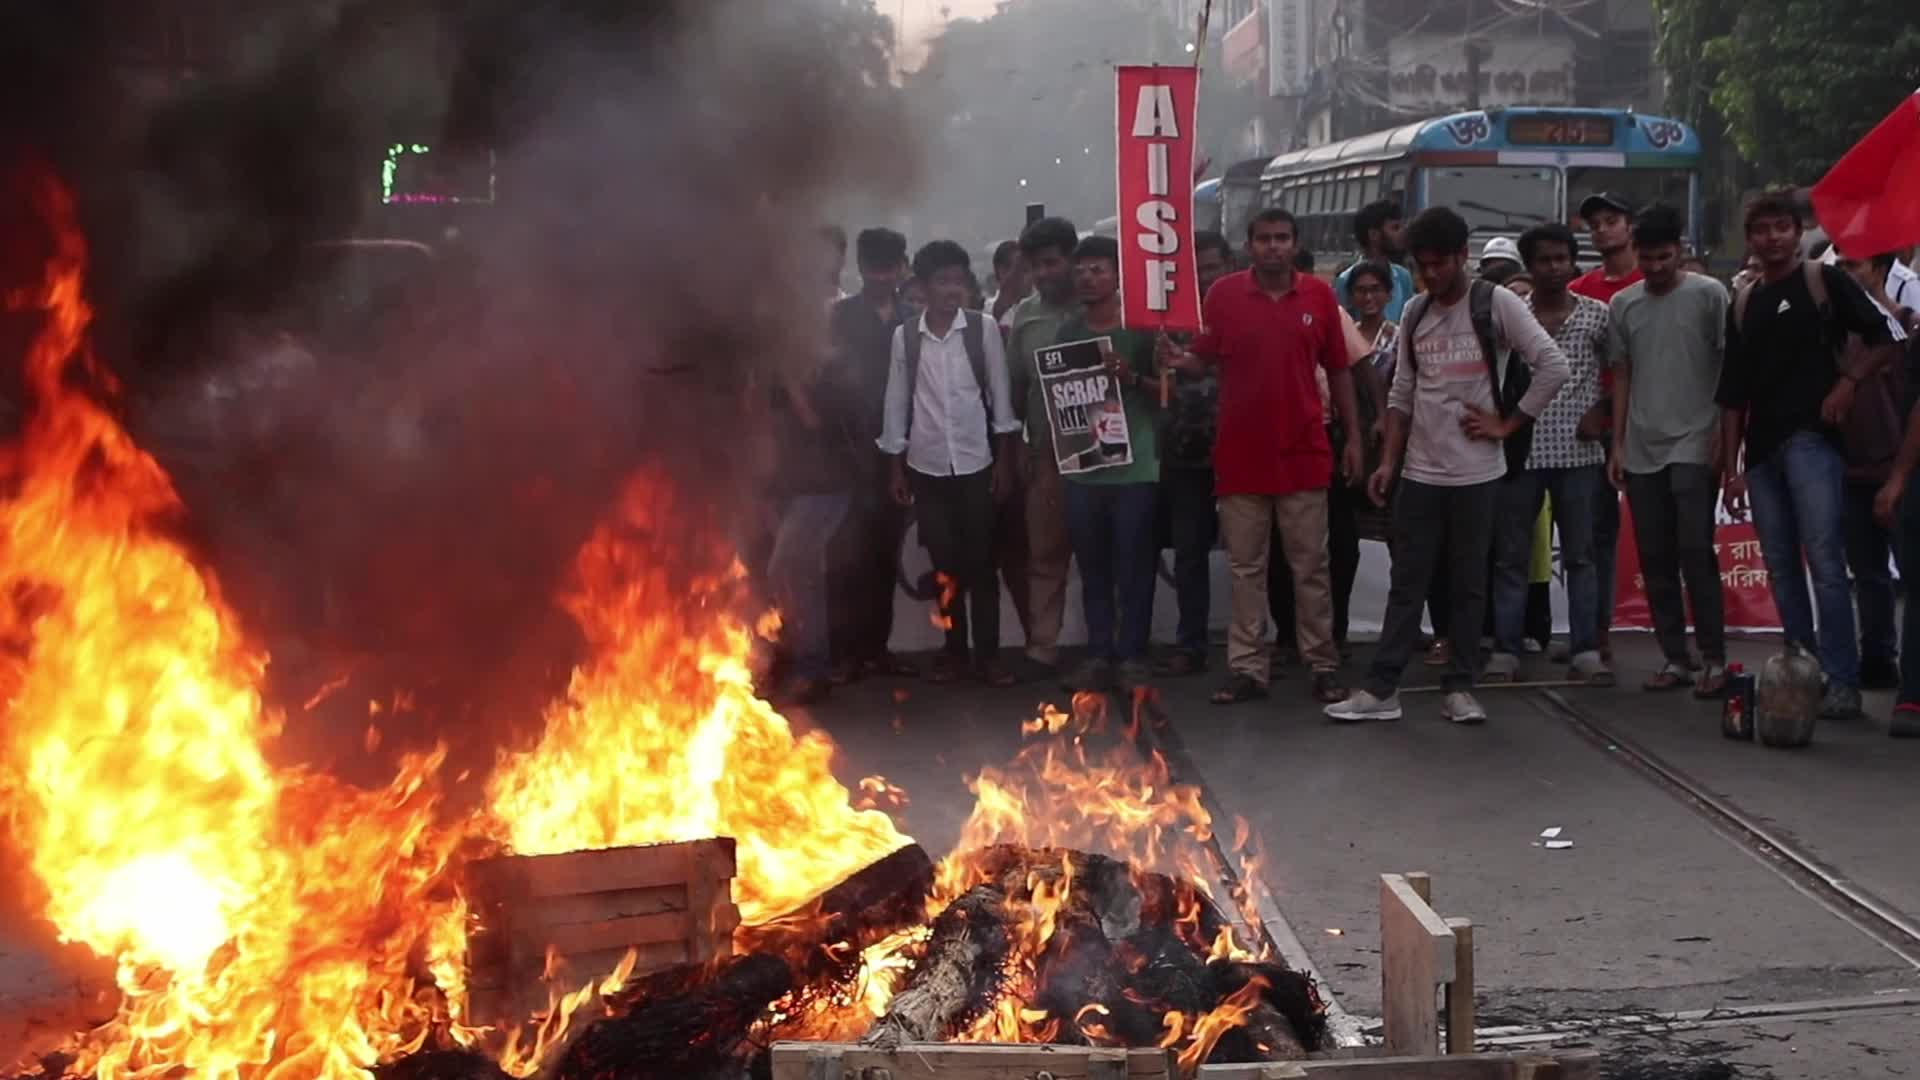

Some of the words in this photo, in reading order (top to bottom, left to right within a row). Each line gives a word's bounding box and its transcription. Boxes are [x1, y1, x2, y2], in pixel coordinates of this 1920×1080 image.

[1132, 85, 1179, 310] AISF
[1045, 351, 1062, 365] SFI
[1052, 376, 1108, 408] SCRAP
